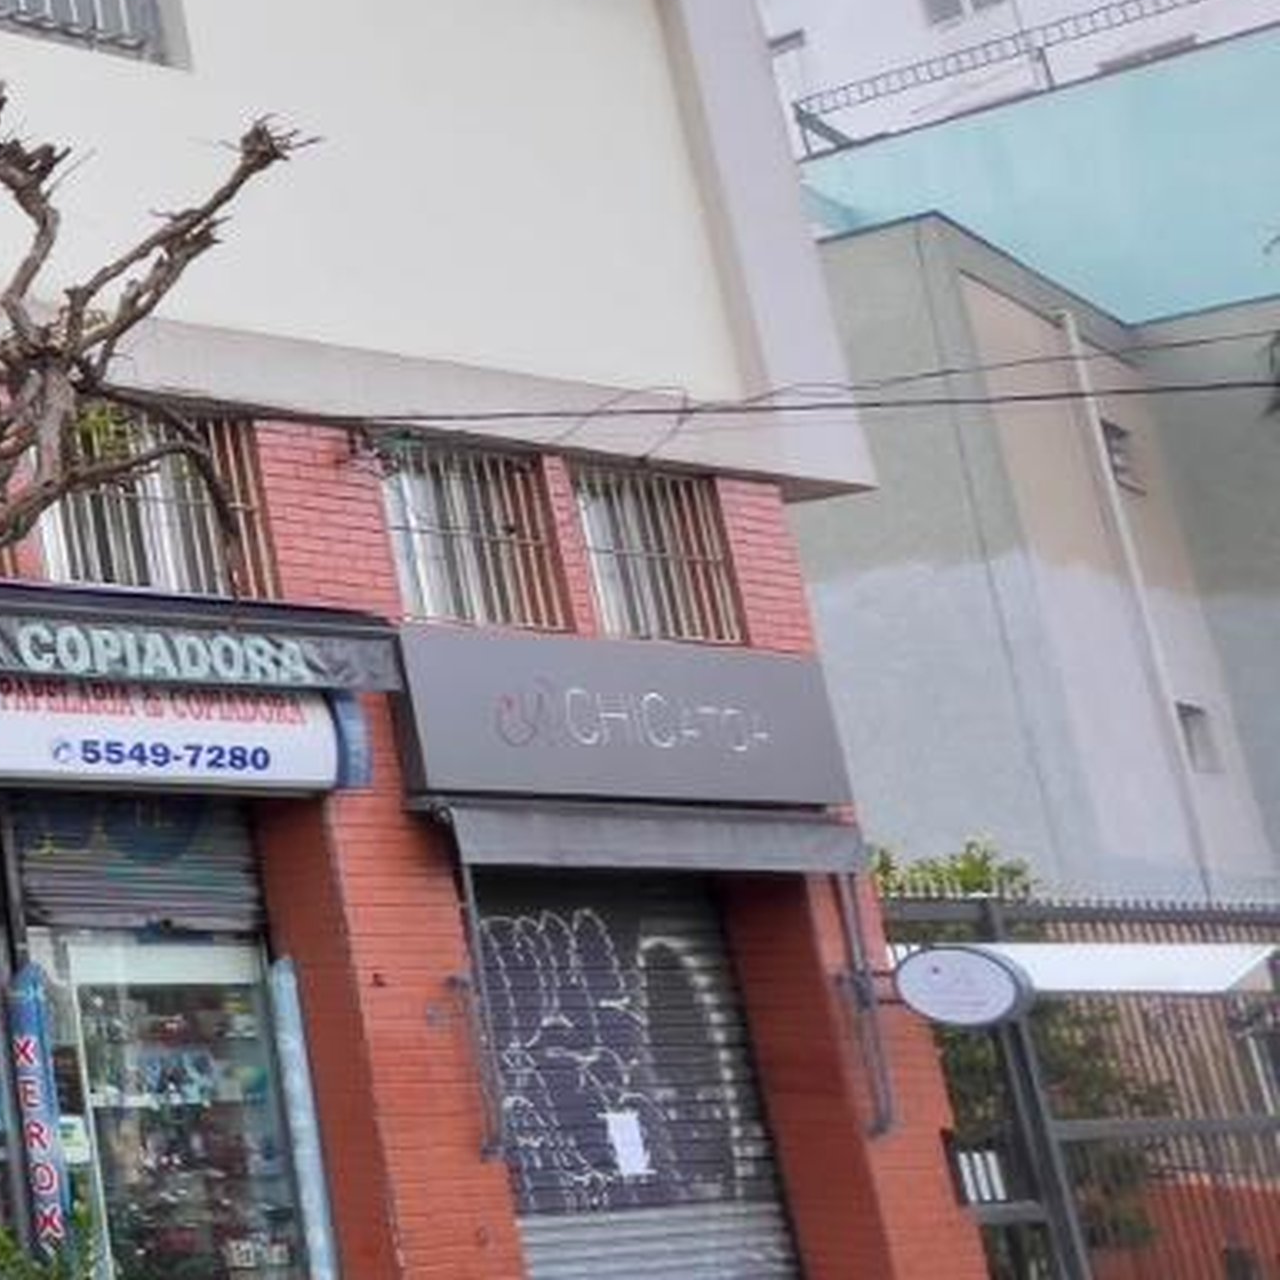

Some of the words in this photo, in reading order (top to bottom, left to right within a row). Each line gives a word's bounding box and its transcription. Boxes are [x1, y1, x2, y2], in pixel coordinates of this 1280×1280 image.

[17, 623, 314, 683] COPIADORA
[81, 740, 271, 771] 5549-7280
[13, 1034, 65, 1240] XEROX
